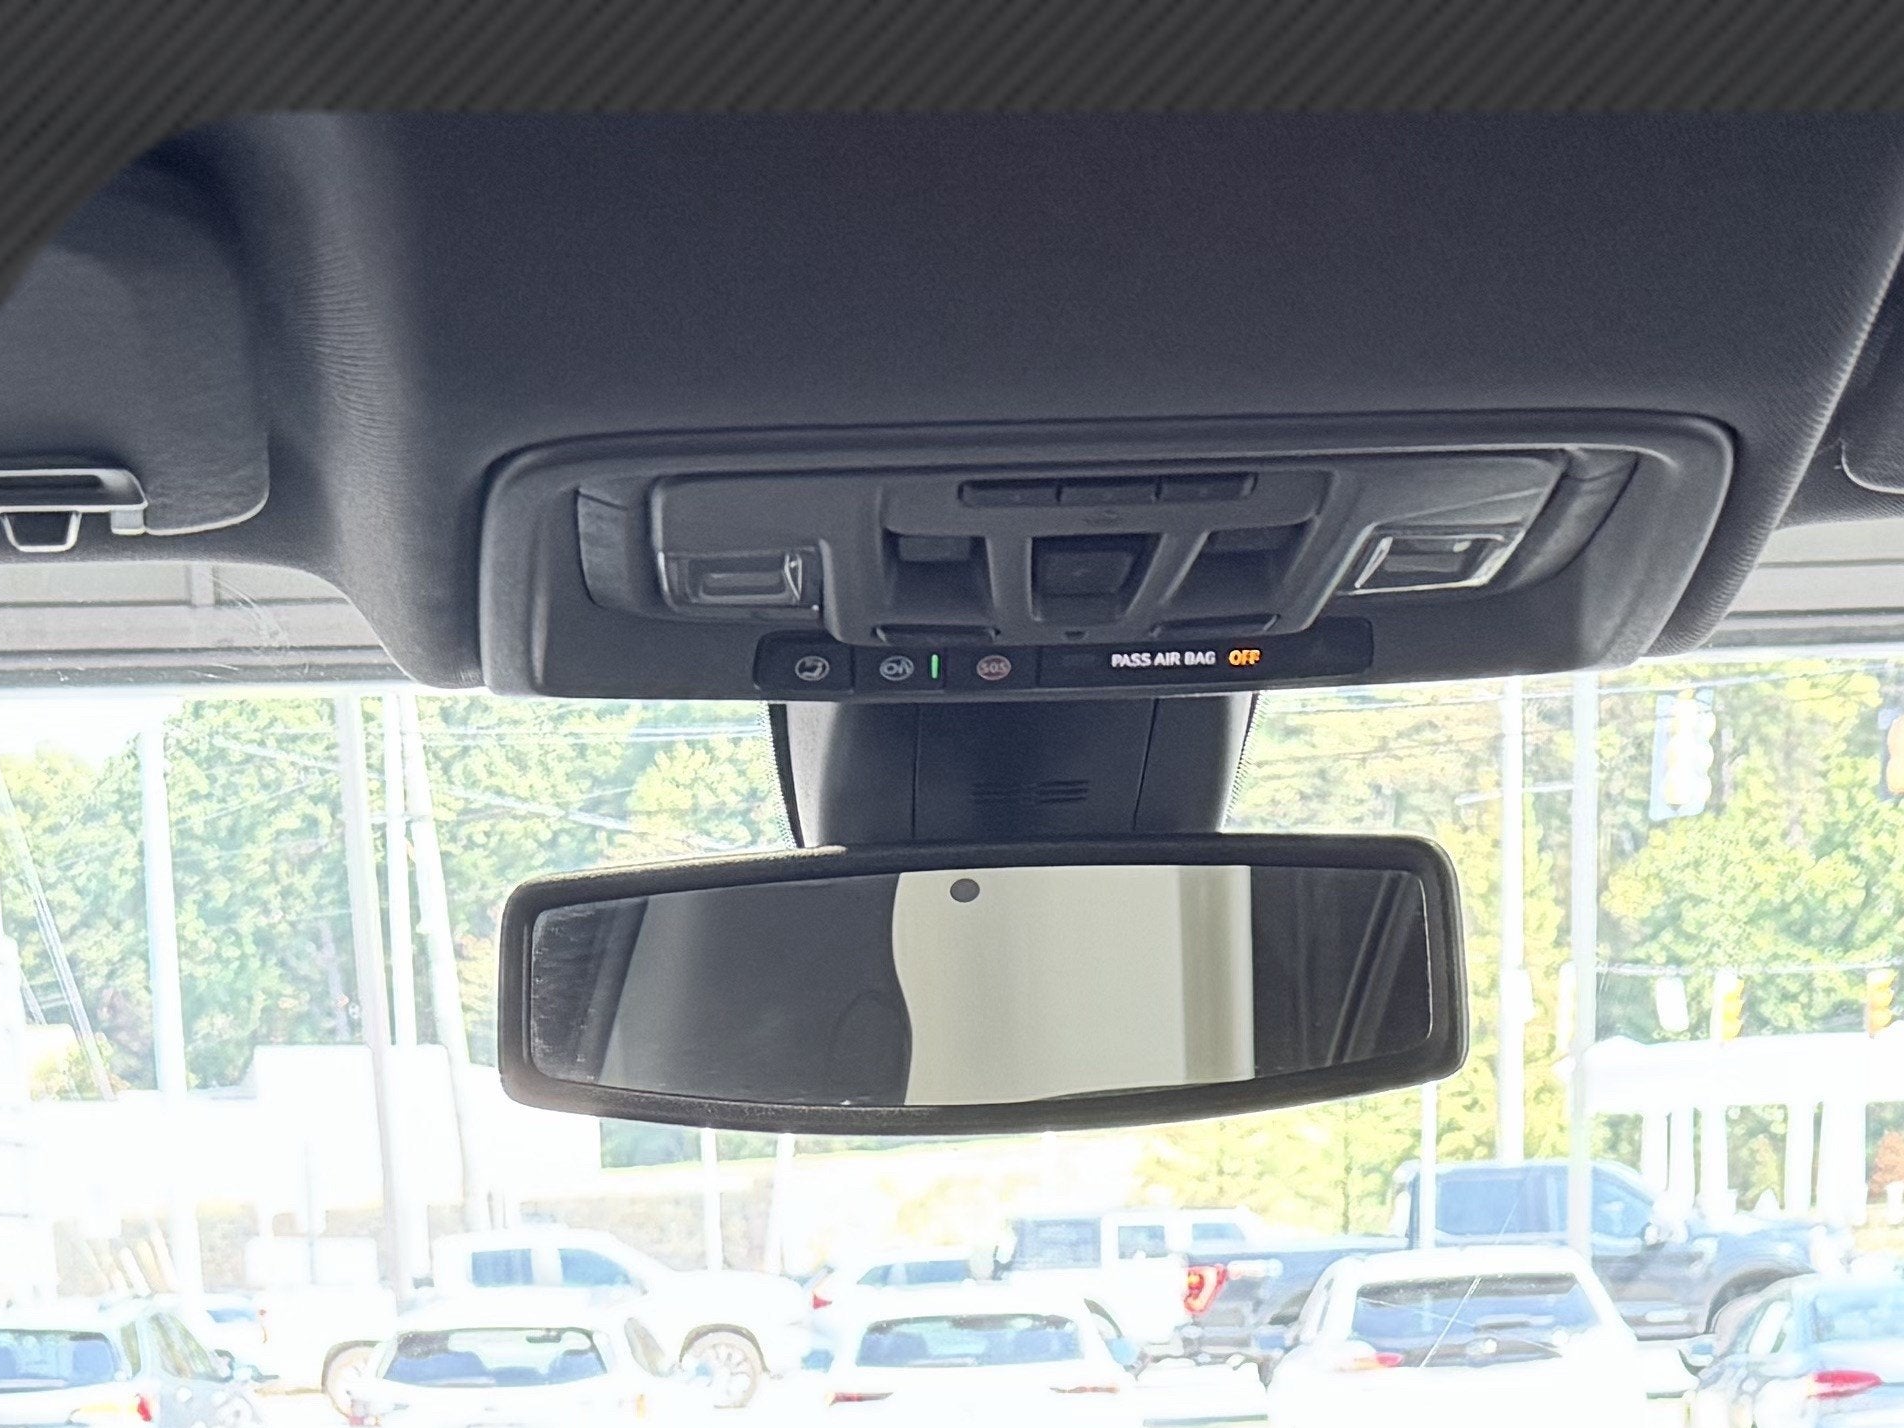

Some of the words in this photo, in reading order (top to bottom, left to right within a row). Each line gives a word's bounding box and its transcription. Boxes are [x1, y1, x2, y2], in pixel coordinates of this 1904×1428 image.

[1112, 652, 1151, 667] PASS
[1154, 651, 1181, 666] AIR
[1184, 650, 1216, 665] BAG
[1228, 649, 1261, 666] OFF
